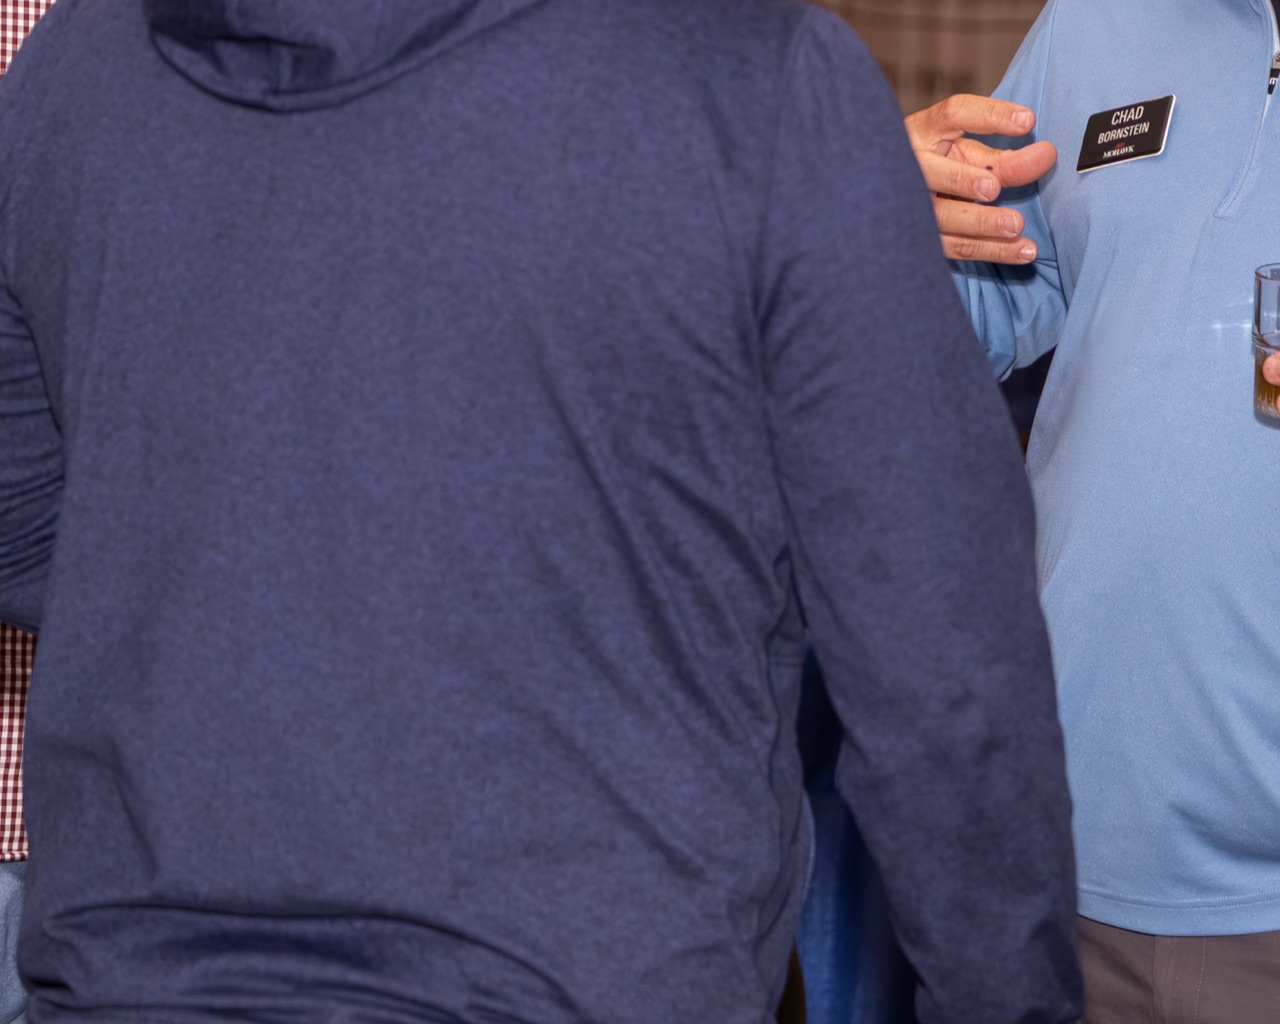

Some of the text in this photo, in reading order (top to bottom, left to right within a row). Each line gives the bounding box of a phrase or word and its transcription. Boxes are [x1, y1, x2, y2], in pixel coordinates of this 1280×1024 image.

[1111, 105, 1145, 125] CHAD
[1097, 121, 1150, 144] BORNSTEIN
[1102, 145, 1135, 158] MOHAWK
